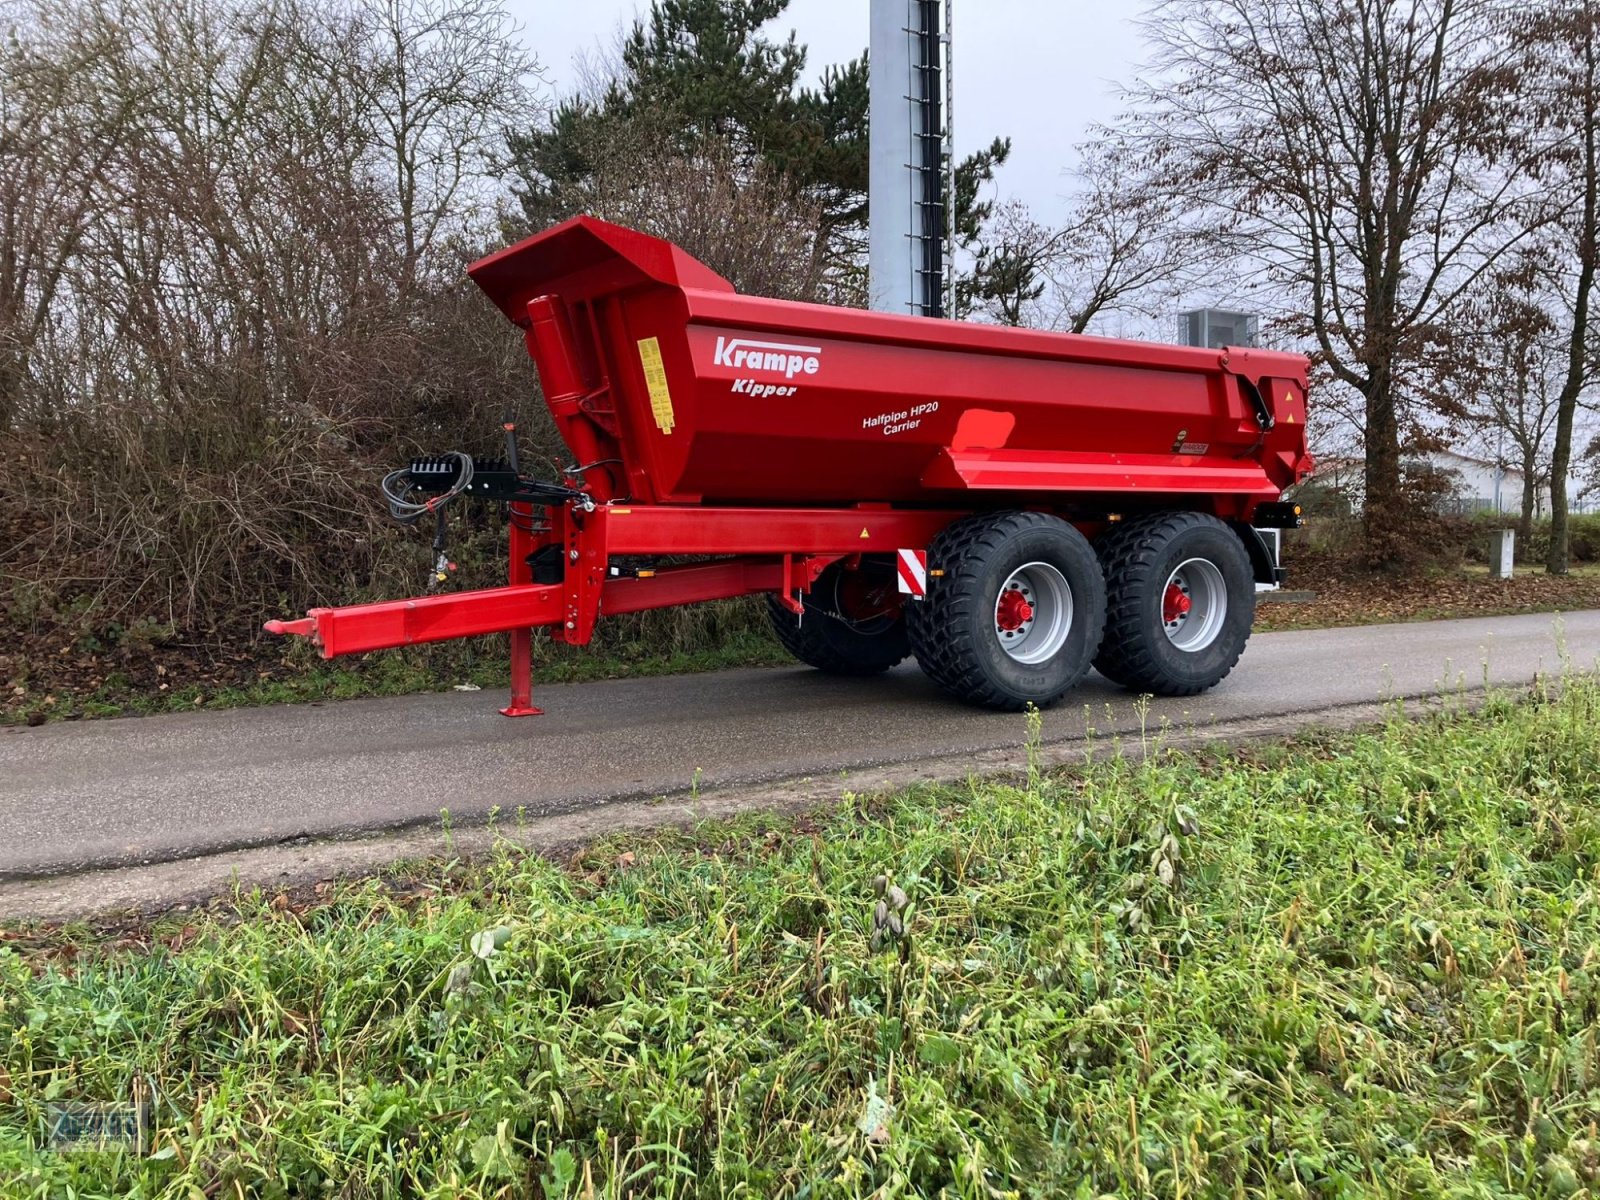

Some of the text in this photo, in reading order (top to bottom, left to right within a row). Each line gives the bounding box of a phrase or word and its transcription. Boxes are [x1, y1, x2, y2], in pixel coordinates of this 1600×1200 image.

[714, 336, 821, 378] Krampe
[731, 379, 797, 398] Kipper
[862, 401, 939, 429] Halfpipe HP20
[883, 419, 921, 435] Carrier
